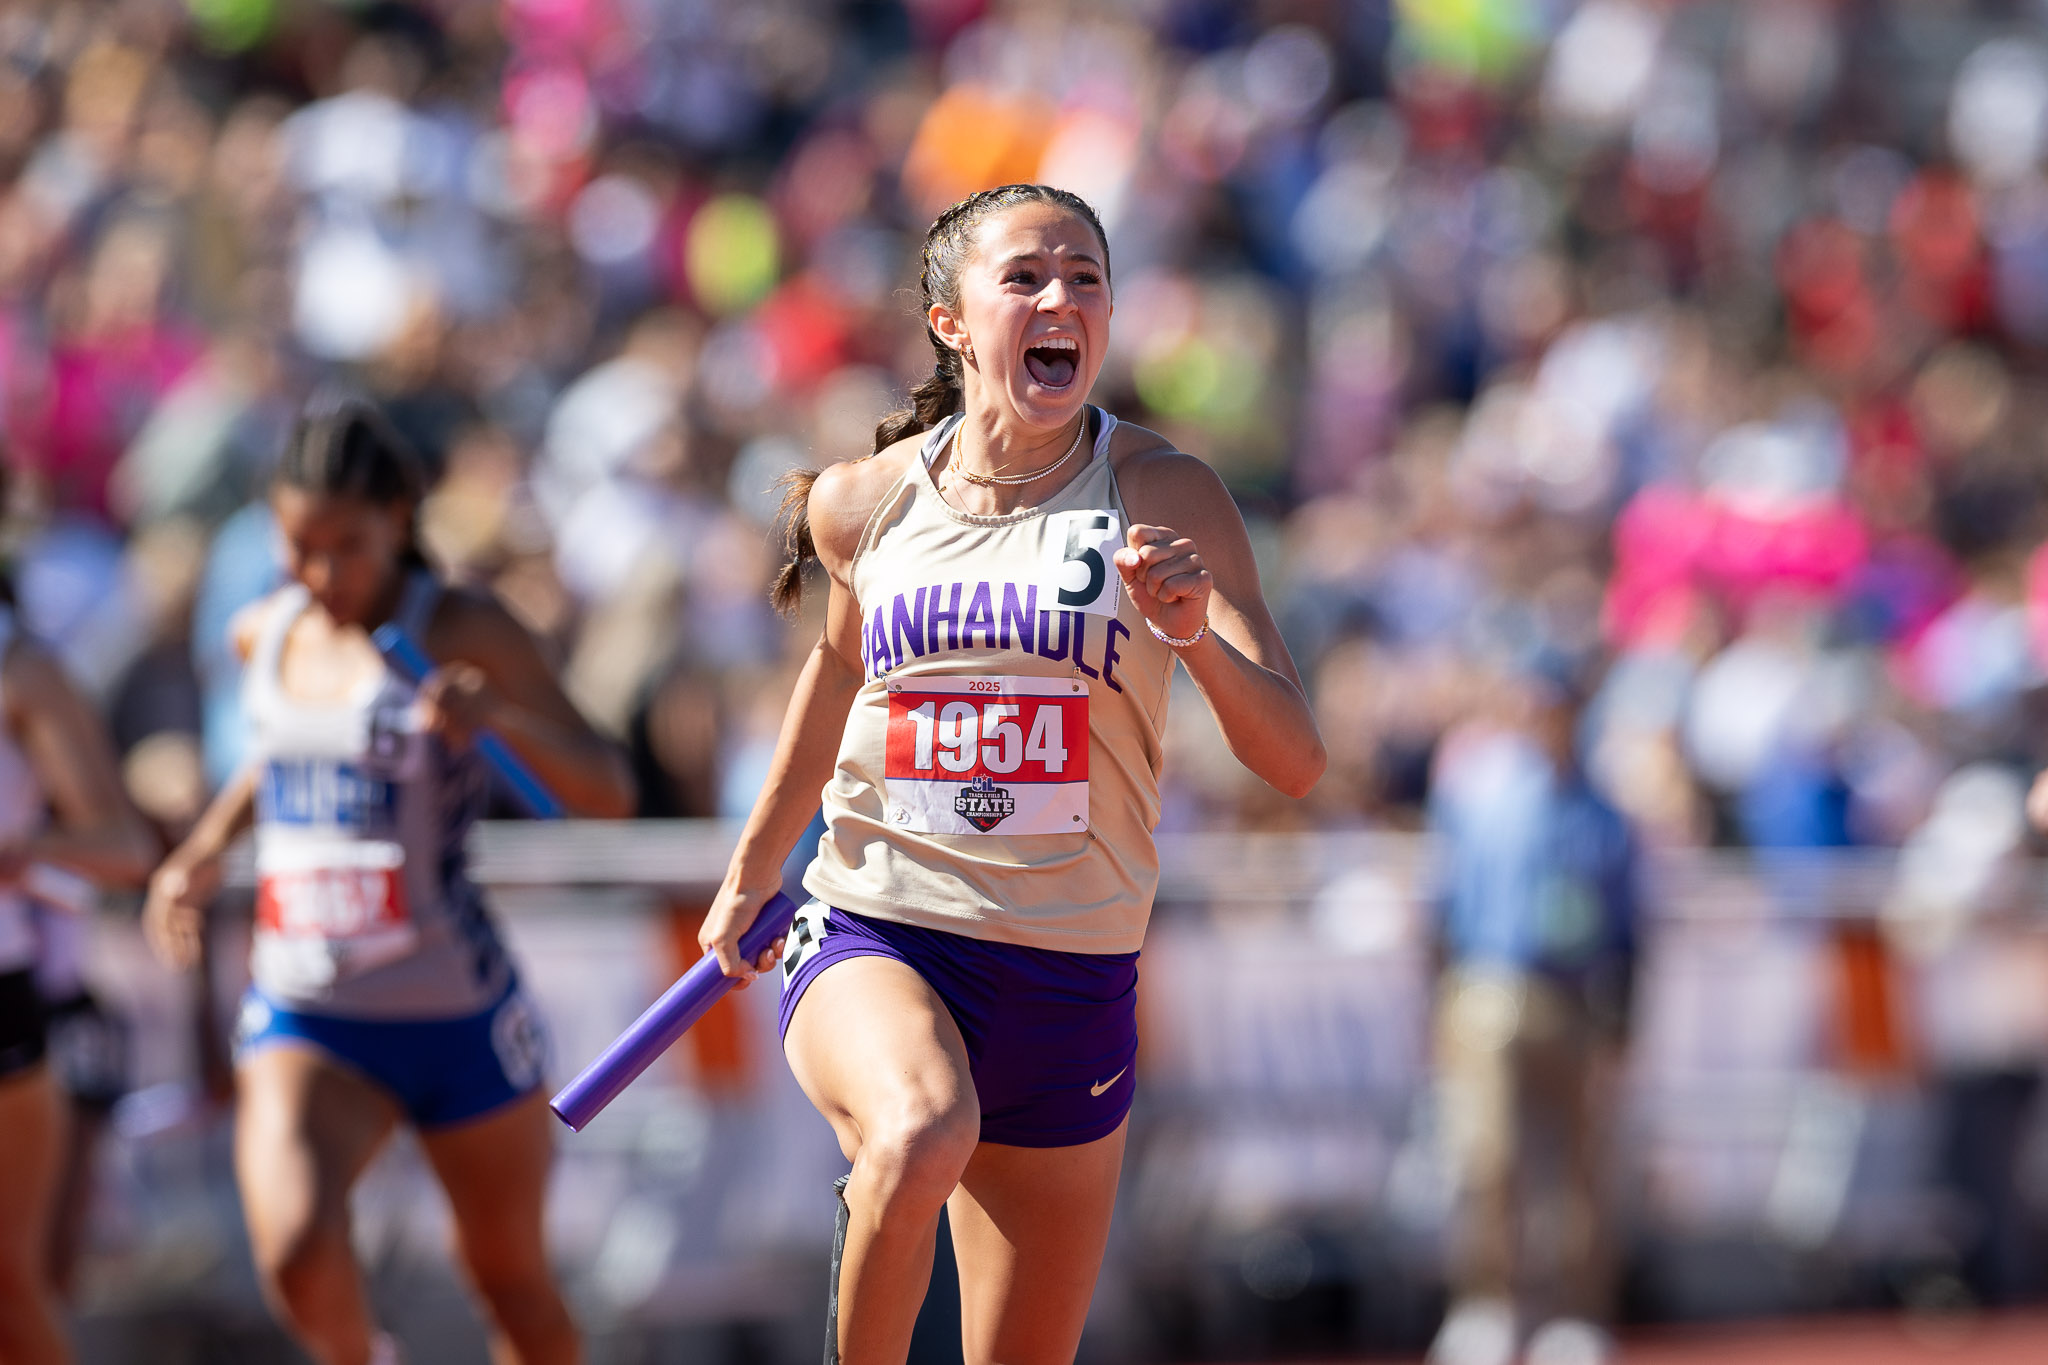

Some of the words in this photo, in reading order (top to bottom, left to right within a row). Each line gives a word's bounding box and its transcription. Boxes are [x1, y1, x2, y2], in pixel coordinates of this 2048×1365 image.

[1058, 516, 1109, 607] 5
[969, 681, 1001, 692] 2025
[906, 701, 1068, 774] 1954
[955, 798, 1013, 812] STATE
